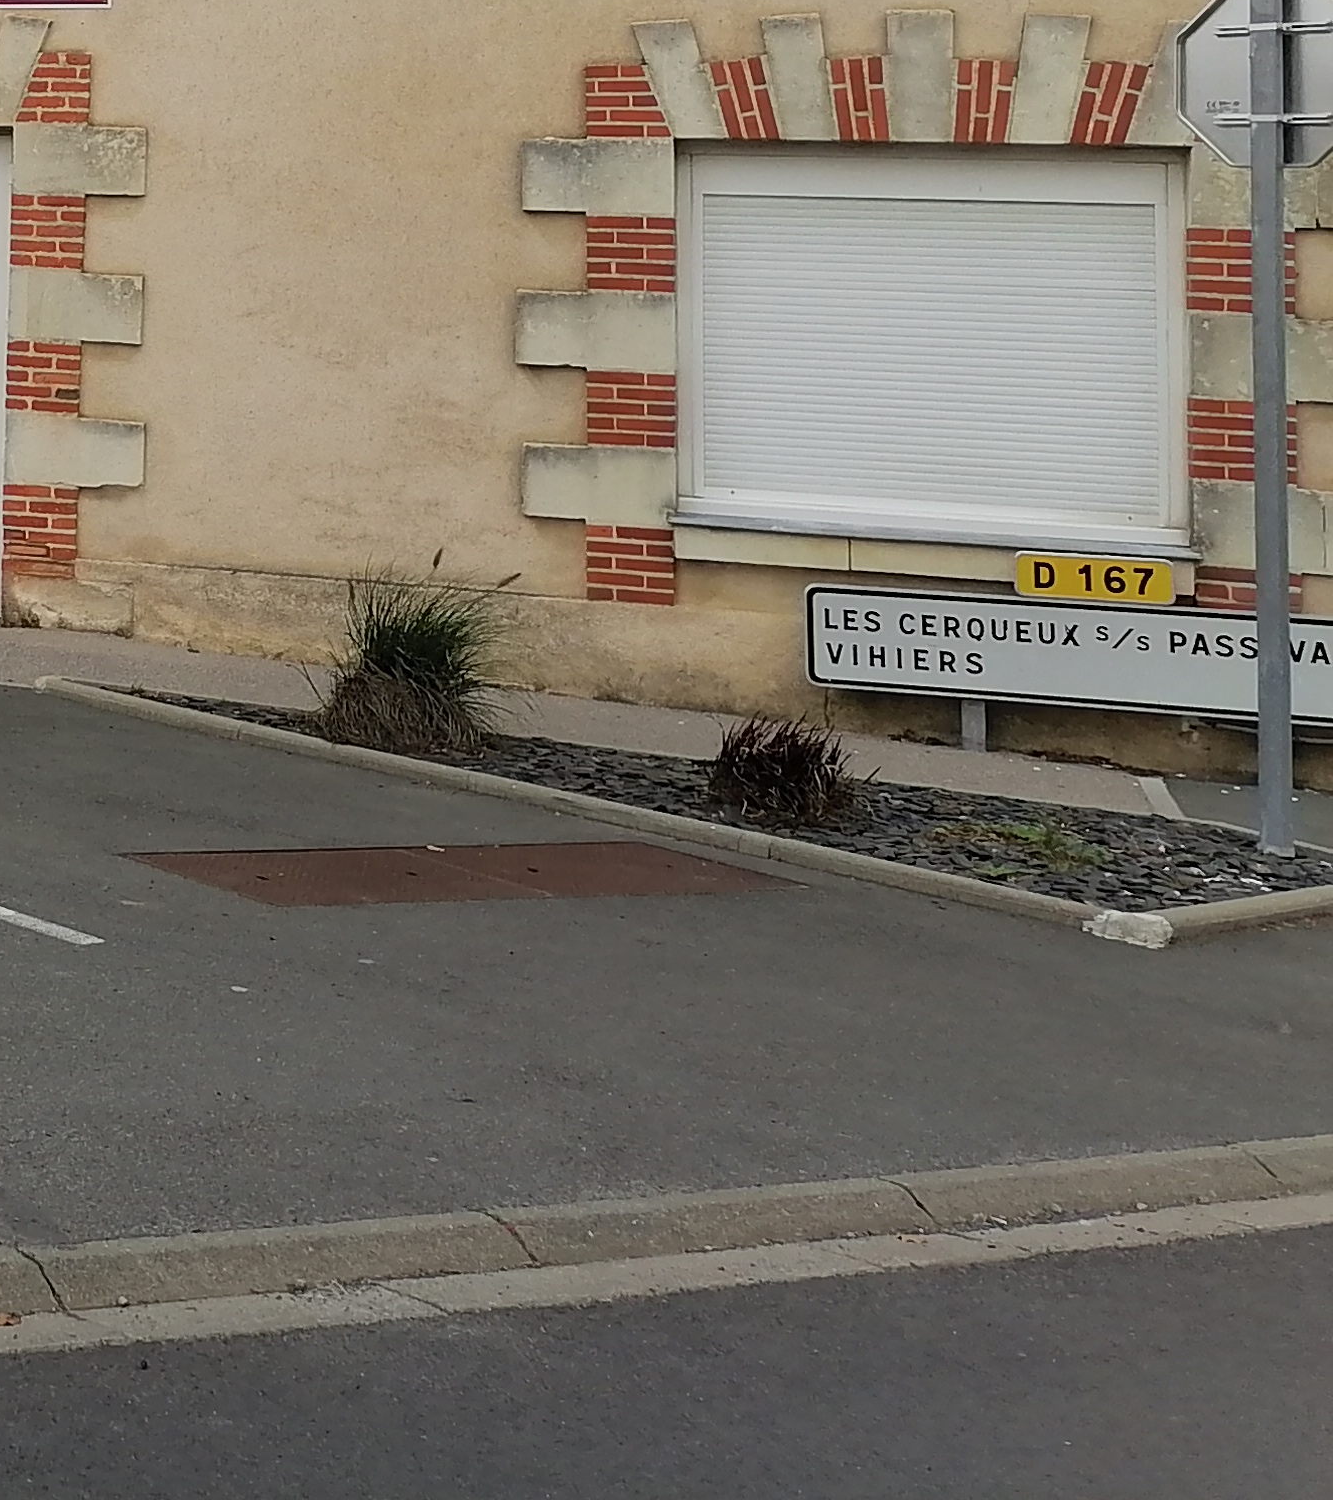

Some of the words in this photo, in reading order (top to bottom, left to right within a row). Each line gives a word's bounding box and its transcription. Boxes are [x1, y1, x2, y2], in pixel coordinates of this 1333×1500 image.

[1033, 561, 1056, 590] D
[1077, 564, 1155, 596] 167
[824, 607, 882, 633] LES
[898, 613, 1081, 648] CERQUEUX
[1169, 630, 1331, 665] PASSVA
[825, 642, 985, 675] VIHIERS
